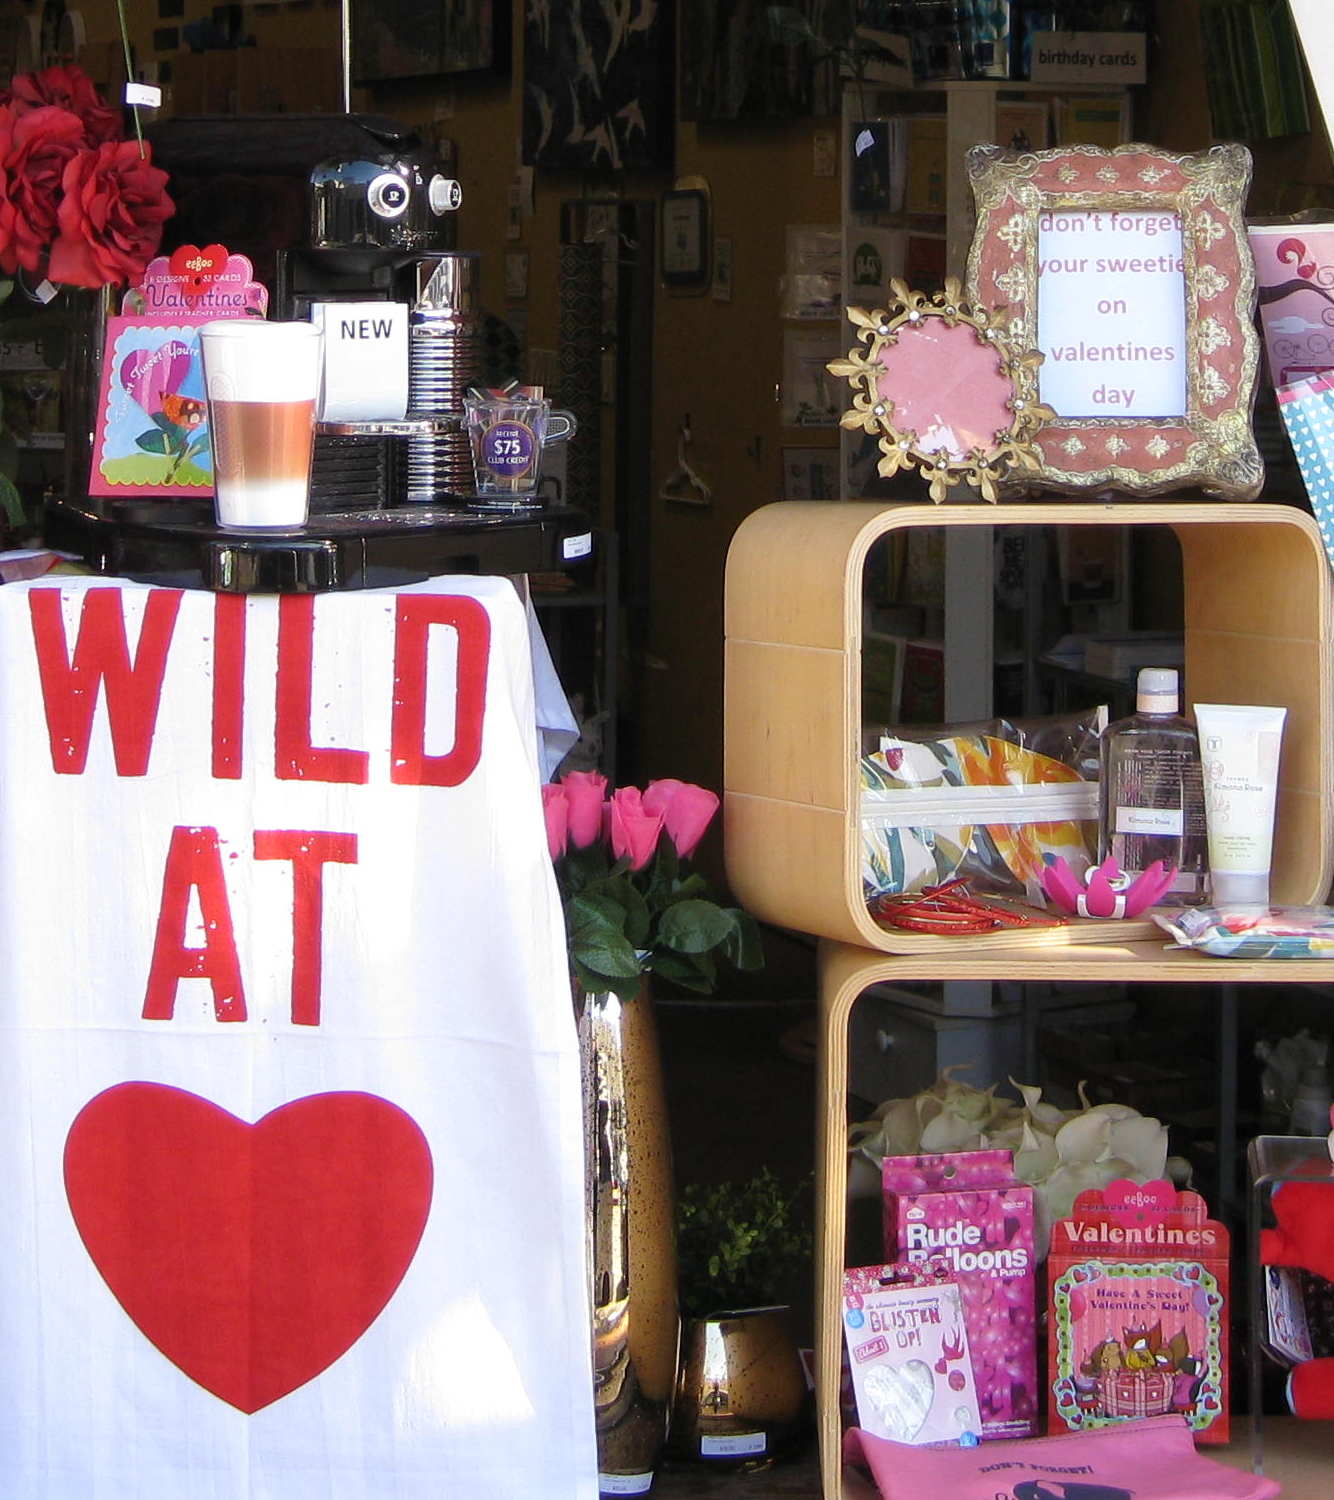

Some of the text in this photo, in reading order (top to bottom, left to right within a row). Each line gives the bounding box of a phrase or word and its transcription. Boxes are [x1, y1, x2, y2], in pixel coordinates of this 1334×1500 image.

[1038, 49, 1137, 68] birthday cards
[1040, 212, 1182, 236] don't forget
[1037, 254, 1185, 277] your sweetie
[146, 284, 248, 308] Valentines
[1097, 299, 1127, 314] on
[341, 319, 392, 339] NEW
[1051, 341, 1176, 361] valentines
[1092, 384, 1136, 408] day
[494, 439, 521, 455] $75
[29, 587, 492, 788] WILD
[1245, 784, 1264, 792] Rose
[141, 826, 357, 1026] AT
[907, 1220, 981, 1248] Rude
[1064, 1221, 1216, 1245] Valentines
[908, 1247, 1028, 1272] Blloons
[991, 1267, 1027, 1278] & Pump
[1096, 1289, 1183, 1299] Have A Sweet
[1090, 1300, 1189, 1313] Valentine's Day!
[870, 1308, 941, 1332] GLISTEN
[897, 1328, 922, 1348] UP!
[979, 1461, 1094, 1474] DON'T FORGET!
